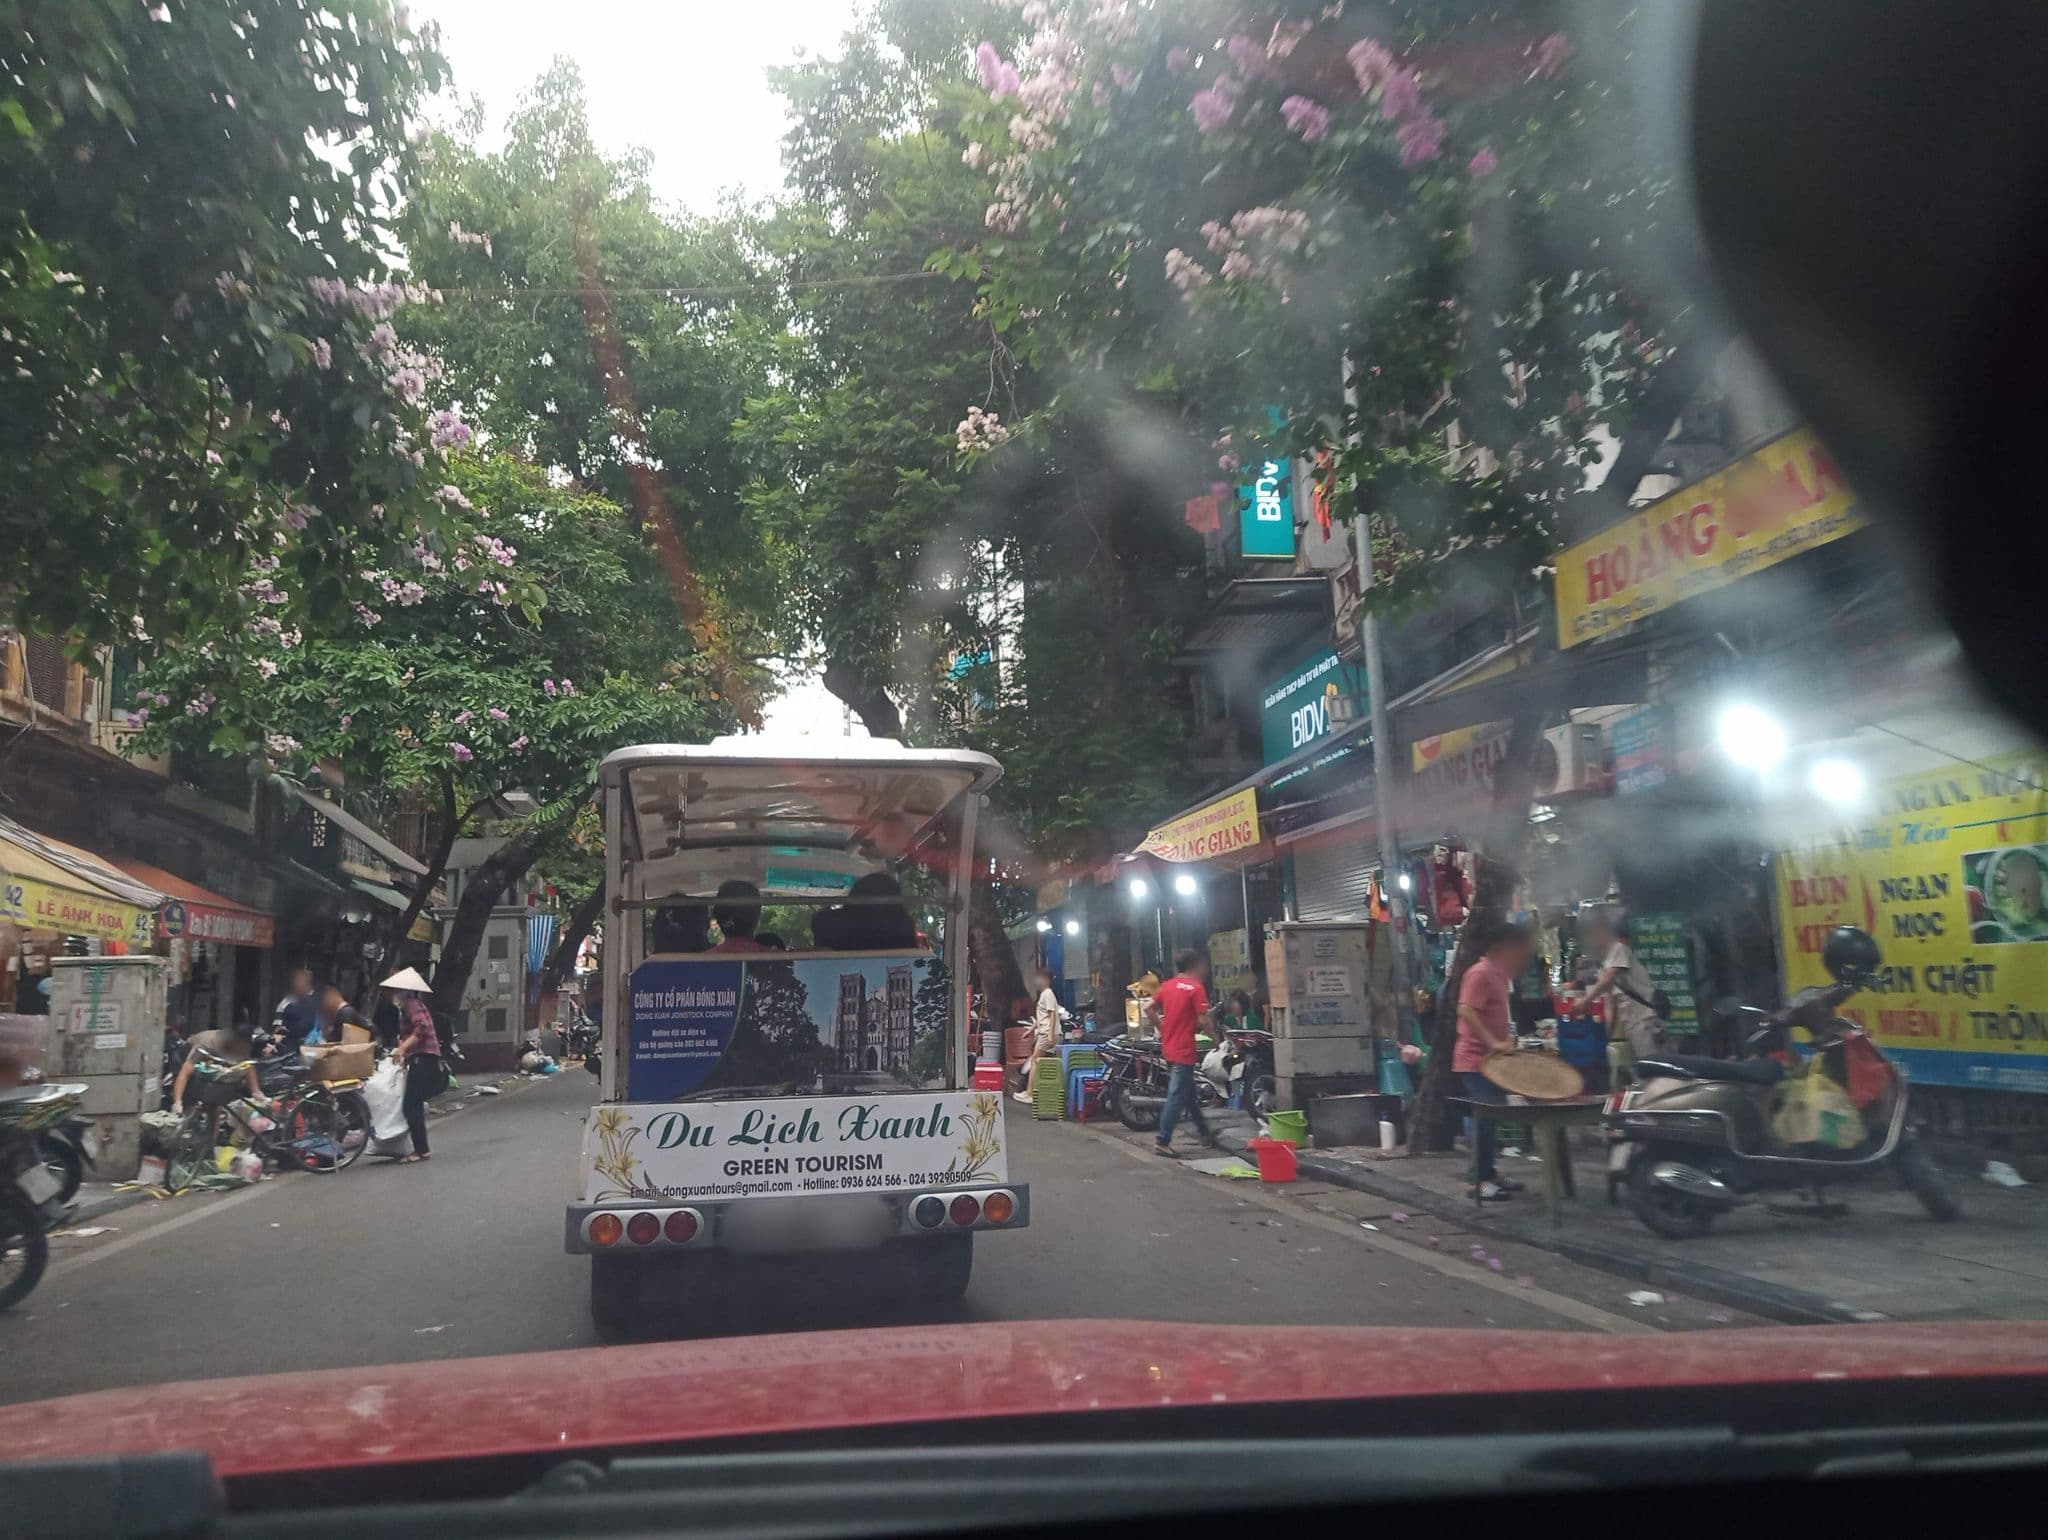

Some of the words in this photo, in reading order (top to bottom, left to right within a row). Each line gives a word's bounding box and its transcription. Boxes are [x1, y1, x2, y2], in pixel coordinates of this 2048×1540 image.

[1291, 695, 1326, 749] BIDV
[1208, 820, 1252, 854] GIANG
[1790, 868, 1850, 908] BÚN
[1878, 872, 1949, 904] NGAN
[62, 905, 92, 923] ANH
[97, 912, 124, 930] HOA
[1893, 911, 1945, 945] MỌC
[634, 989, 654, 1009] CÔNG
[655, 992, 664, 1008] TY
[665, 986, 675, 1008] CỔ
[716, 988, 736, 1007] XUÂN
[705, 1010, 734, 1019] COMPANY
[646, 1111, 717, 1149] Du
[727, 1107, 824, 1153] Lịch
[838, 1102, 954, 1142] Xanh
[723, 1157, 789, 1177] GREEN
[795, 1153, 883, 1173] TOURISM
[662, 1181, 793, 1199] dongxuantours@gmail.com
[803, 1177, 839, 1191] Hotline:
[841, 1175, 864, 1189] 0936
[866, 1174, 882, 1188] 624
[885, 1174, 901, 1187] 566
[909, 1172, 926, 1185] 024
[928, 1170, 972, 1185] 39290509
